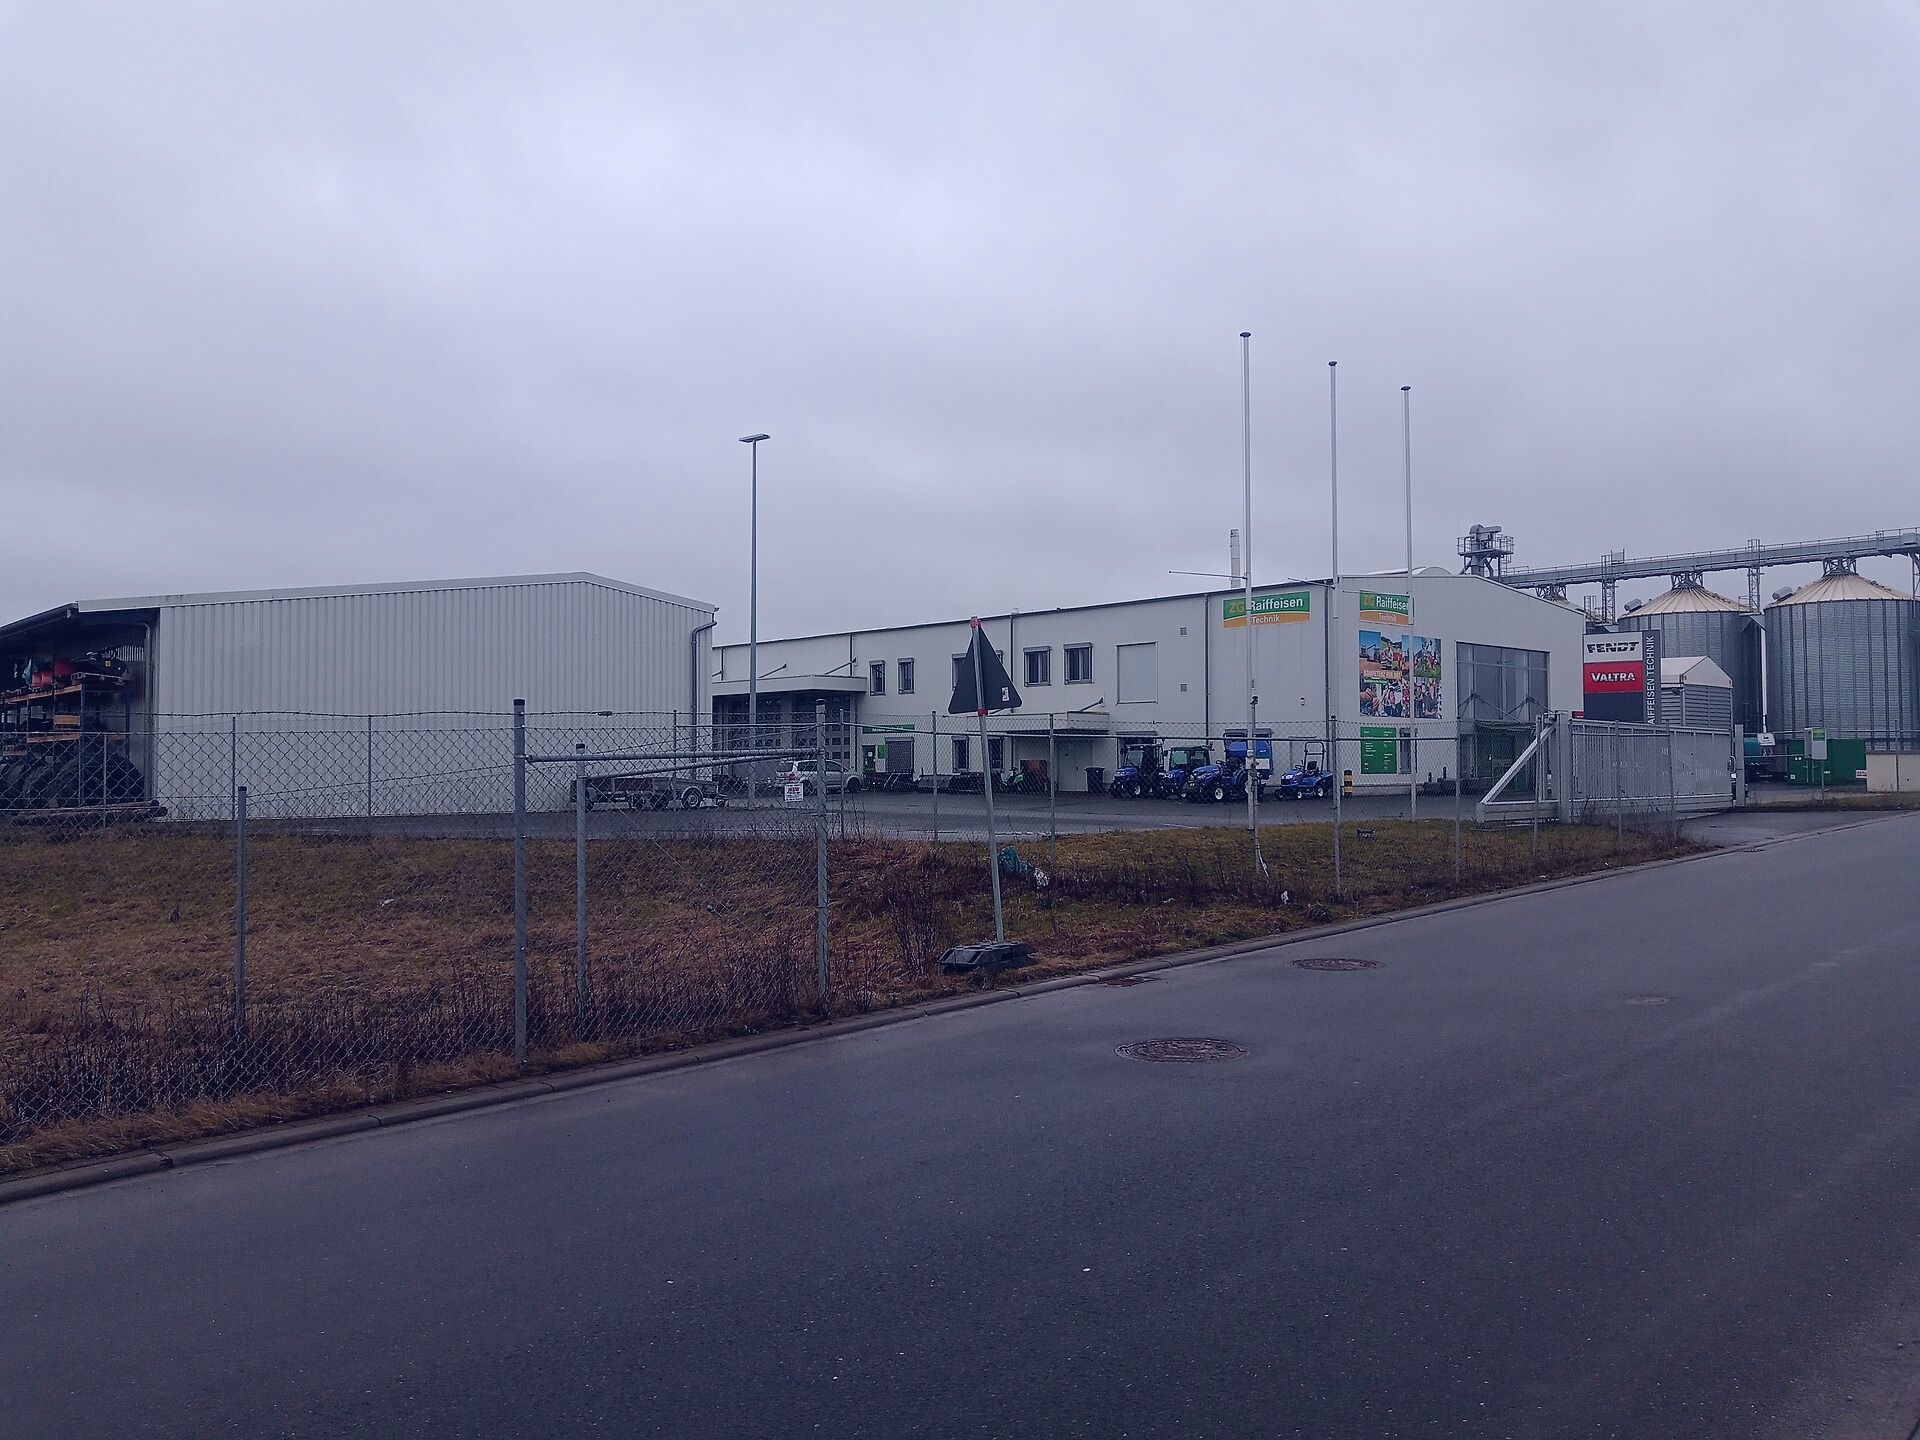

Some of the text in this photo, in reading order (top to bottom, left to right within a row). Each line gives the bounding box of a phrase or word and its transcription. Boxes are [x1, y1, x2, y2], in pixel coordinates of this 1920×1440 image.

[1229, 598, 1303, 613] ZG Raiffeisen
[1363, 594, 1375, 606] ZG
[1251, 615, 1280, 624] Technik
[1378, 613, 1397, 622] Technik
[1586, 641, 1640, 653] FENDT
[1591, 672, 1635, 682] VALTRA
[1645, 635, 1656, 725] AIFFEISEN TECHNIK
